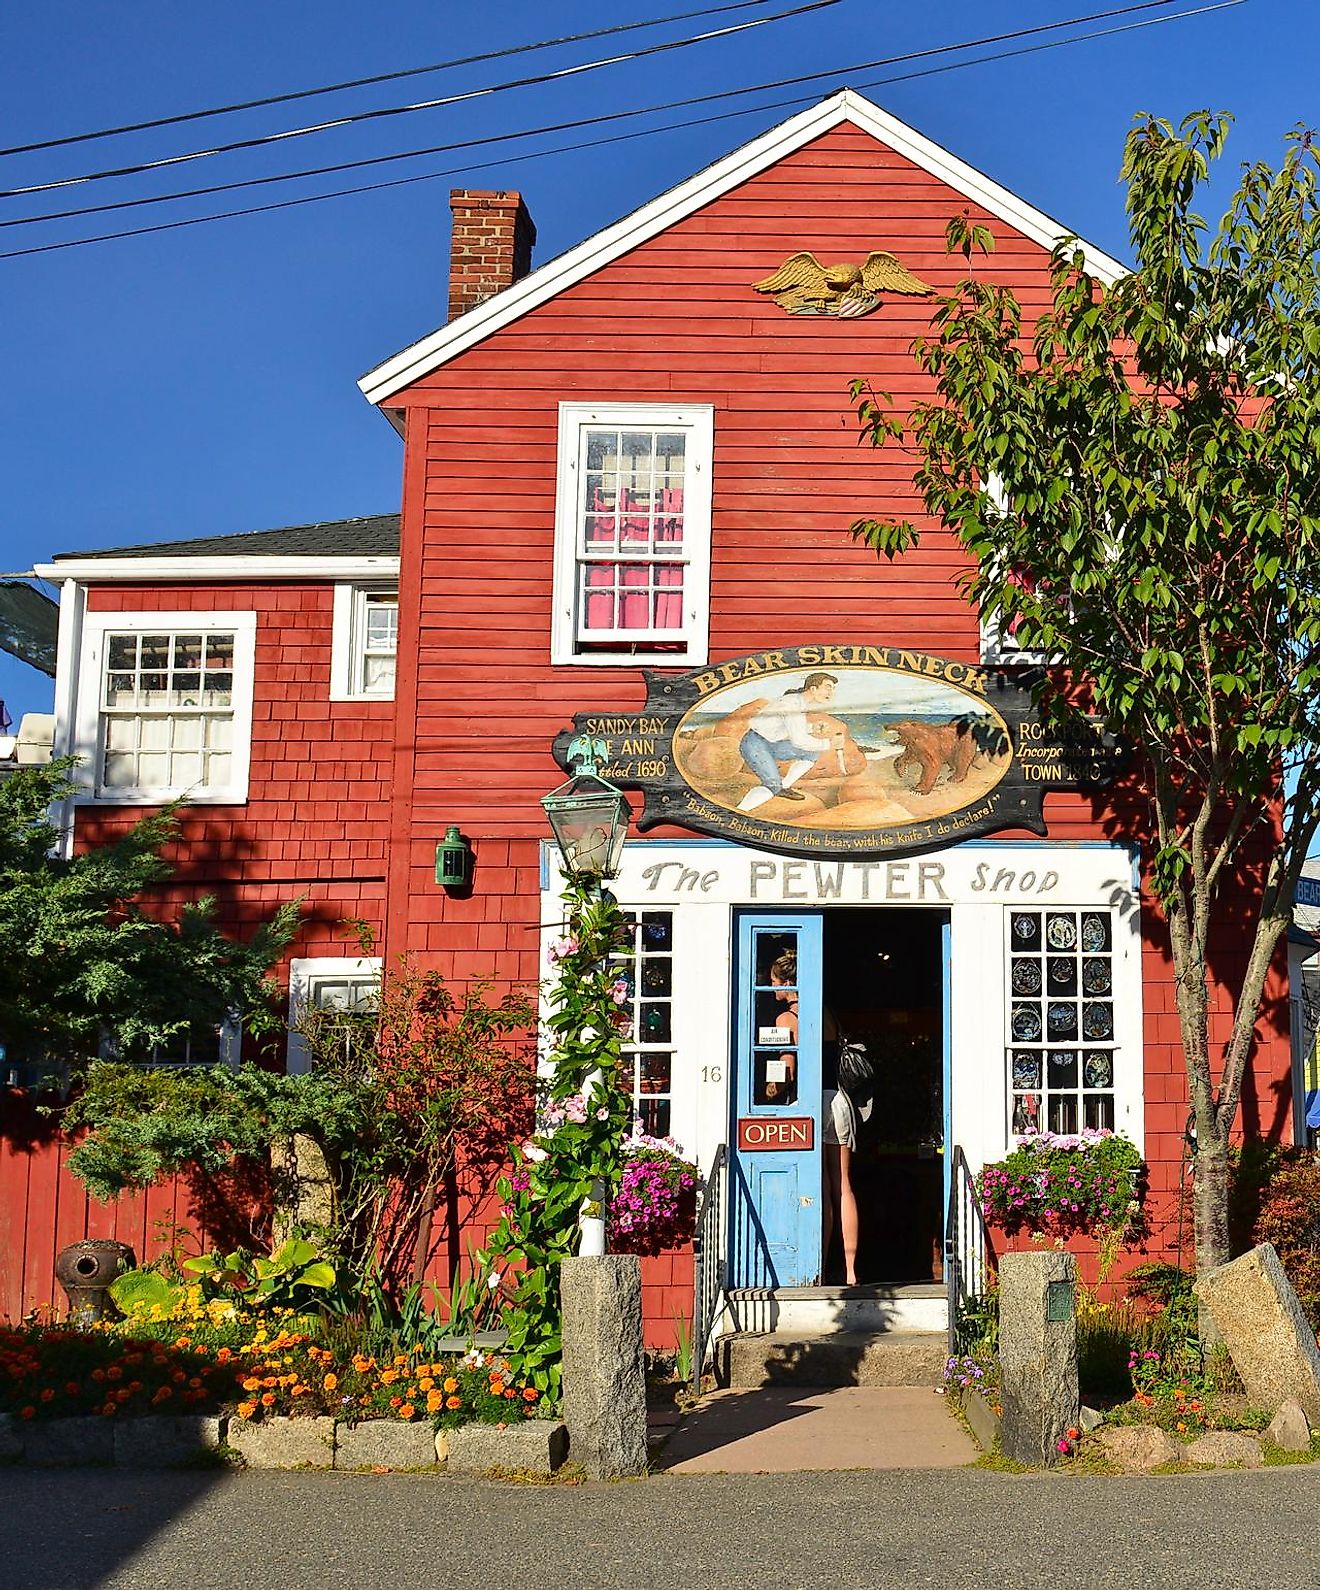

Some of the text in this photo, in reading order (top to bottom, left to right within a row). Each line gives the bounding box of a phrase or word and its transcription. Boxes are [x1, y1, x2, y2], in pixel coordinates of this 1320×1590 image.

[690, 646, 988, 696] BEAR SKIN NECK
[586, 718, 669, 735] SANDY BAY
[621, 739, 655, 755] ANN
[636, 760, 667, 777] 1690
[1023, 764, 1062, 780] TOWN
[770, 828, 799, 844] Killed
[803, 835, 820, 847] the
[924, 826, 933, 838] I
[937, 823, 950, 835] do
[641, 861, 1060, 899] The PEWTER Shop
[701, 1065, 722, 1083] 16
[745, 1124, 808, 1143] OPEN
